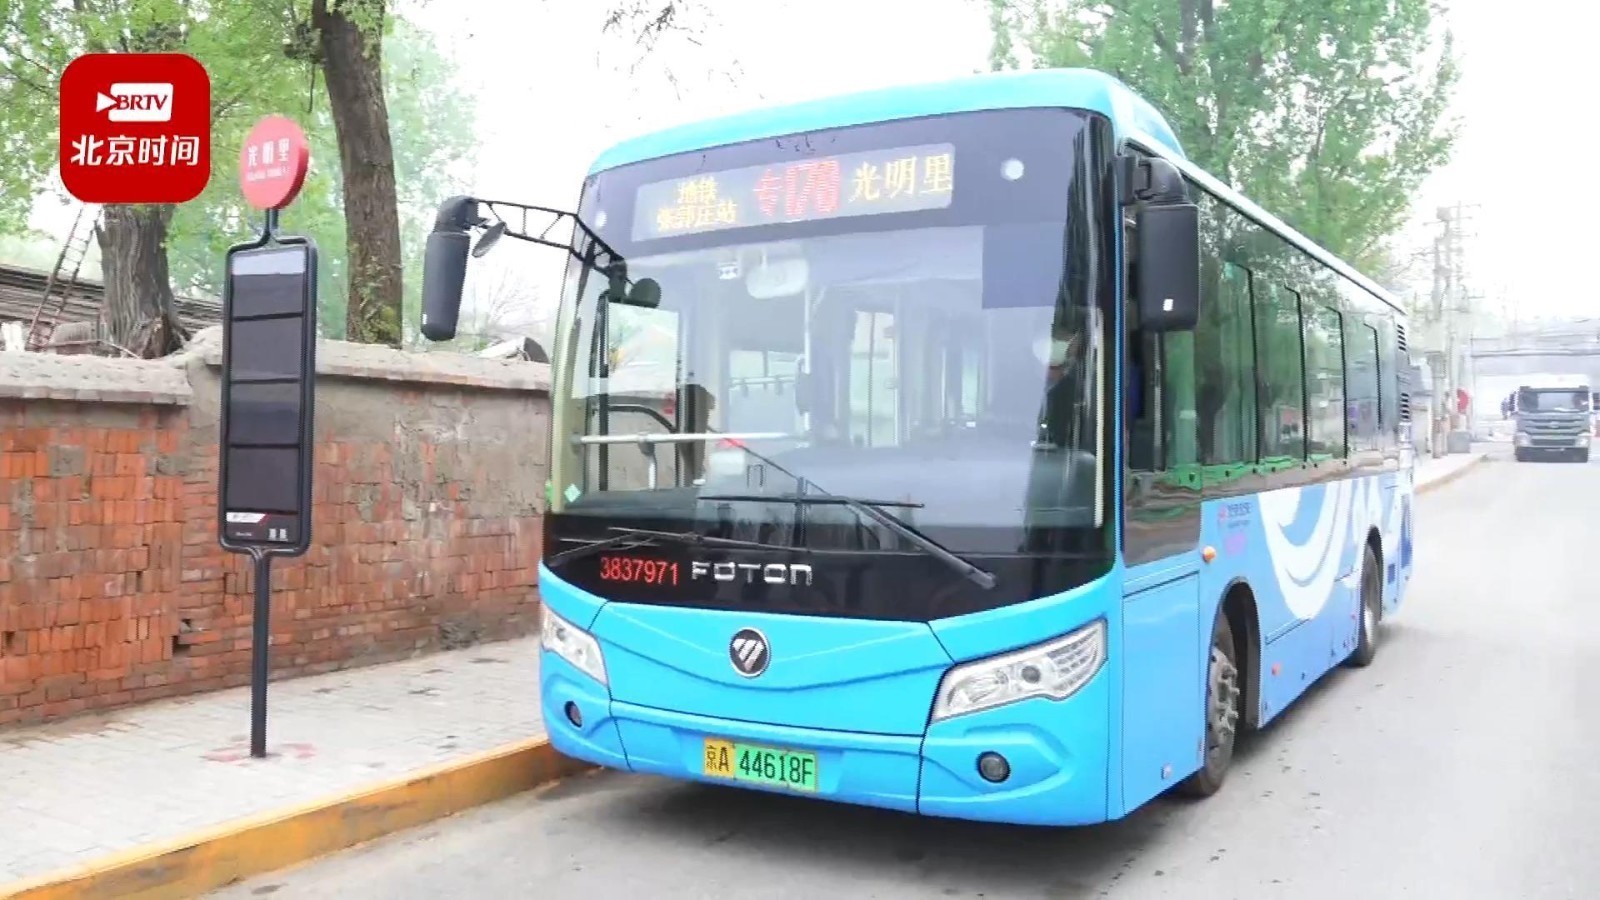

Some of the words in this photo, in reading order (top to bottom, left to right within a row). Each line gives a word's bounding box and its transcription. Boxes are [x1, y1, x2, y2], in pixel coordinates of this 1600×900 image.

[849, 153, 953, 201] 光明里
[600, 556, 679, 586] 3837971
[692, 561, 812, 586] FOTON
[706, 745, 729, 772] 京A
[739, 750, 814, 785] 44618F
